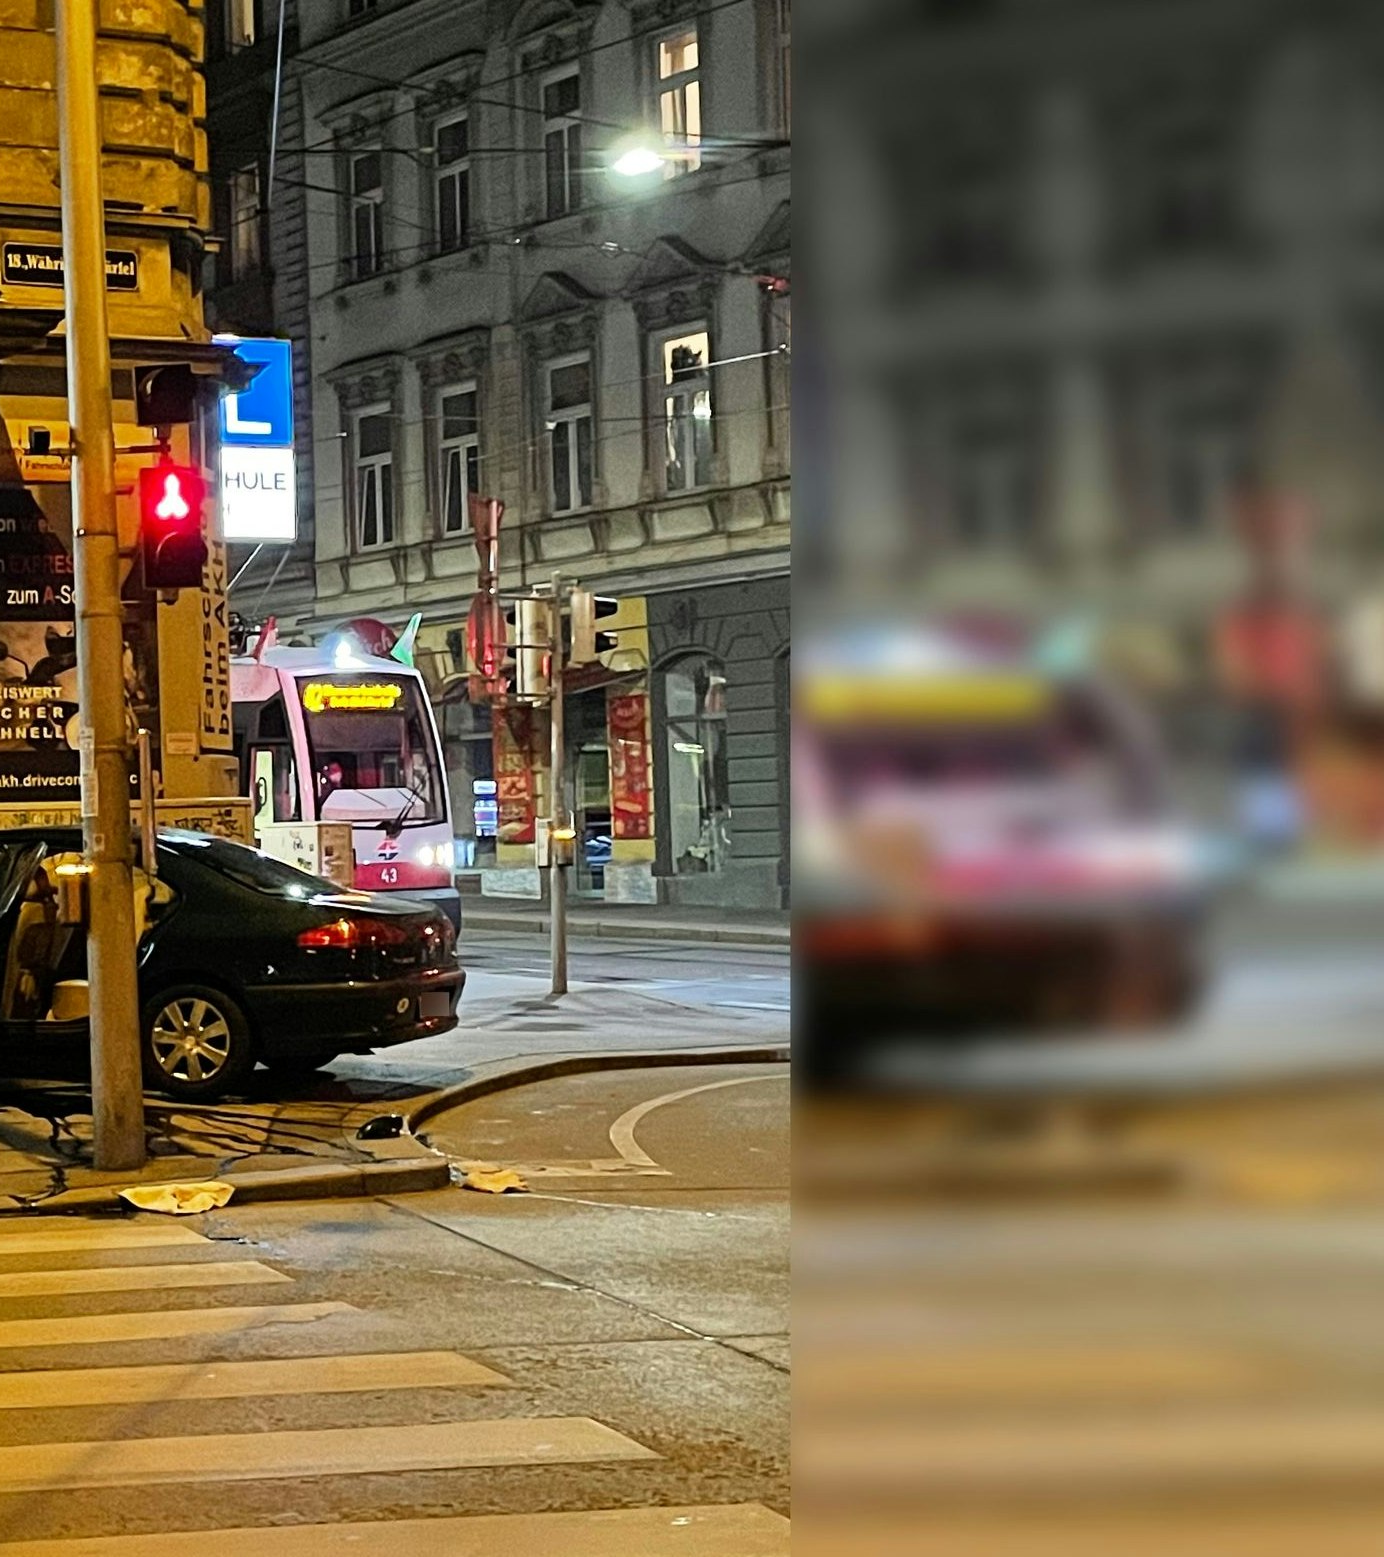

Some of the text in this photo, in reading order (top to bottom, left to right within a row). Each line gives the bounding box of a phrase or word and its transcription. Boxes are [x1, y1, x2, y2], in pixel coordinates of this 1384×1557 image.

[105, 260, 135, 275] ürtel
[225, 472, 286, 491] HULE
[212, 540, 225, 628] AKH
[7, 588, 39, 605] zum
[381, 867, 398, 884] 43
